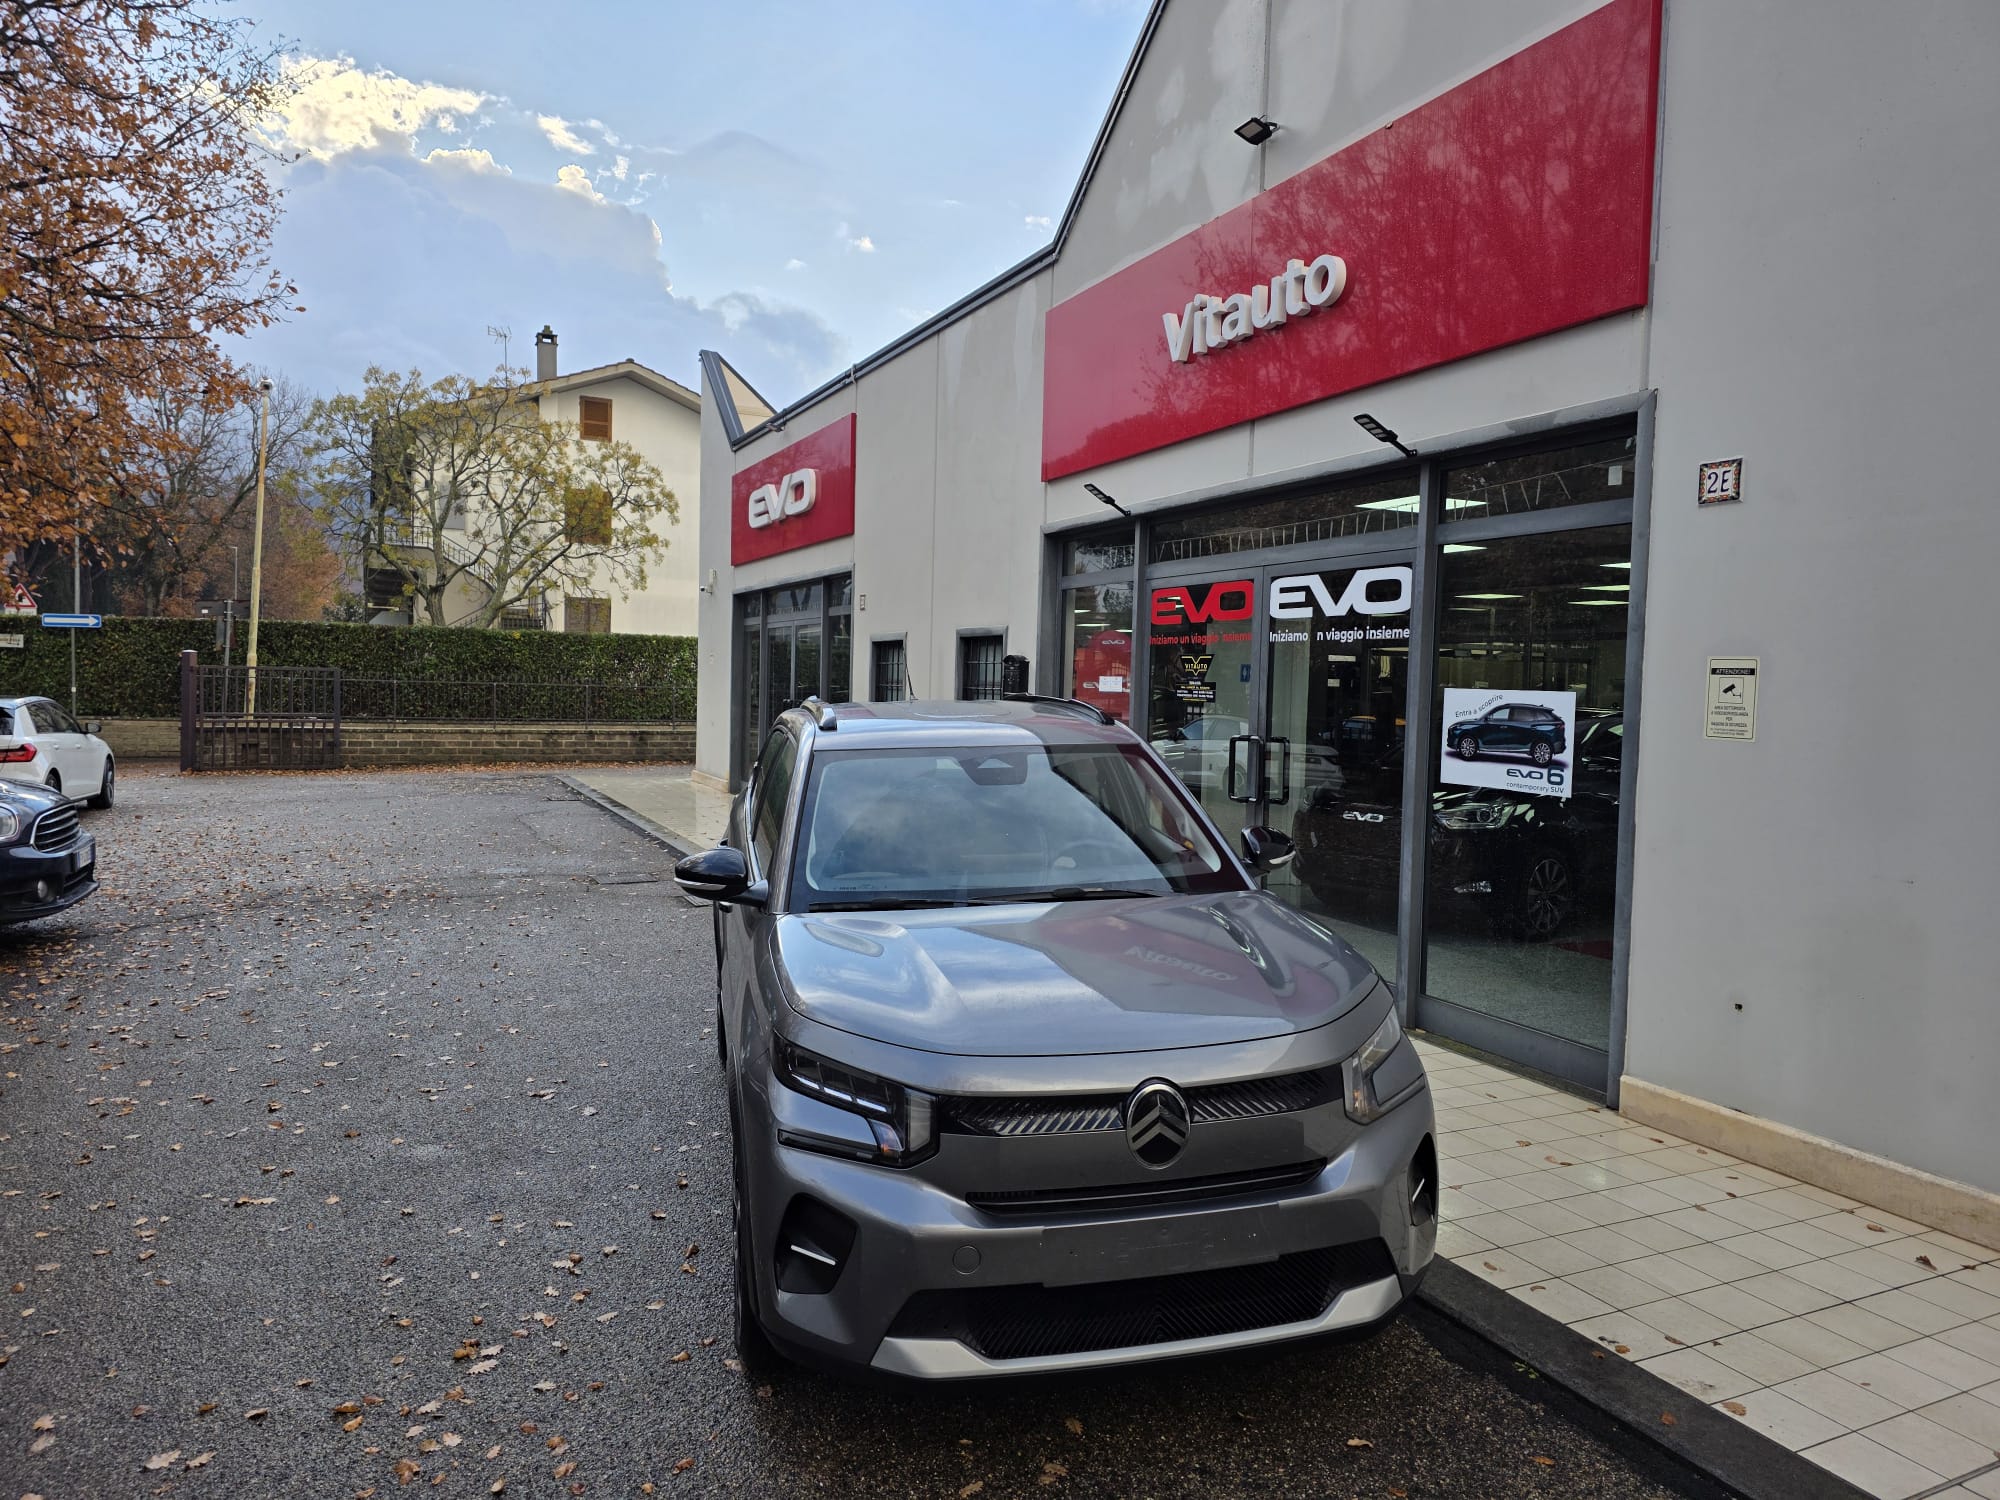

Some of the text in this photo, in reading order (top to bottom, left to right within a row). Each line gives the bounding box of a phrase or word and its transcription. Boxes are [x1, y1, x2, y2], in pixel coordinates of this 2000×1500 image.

[1163, 254, 1346, 363] Vitauto
[1707, 469, 1732, 493] 2E
[749, 468, 816, 528] EVO
[1151, 580, 1254, 625] EVO
[1269, 566, 1412, 619] EVO
[1180, 634, 1190, 645] un
[1269, 629, 1308, 642] Iniziamo
[1326, 627, 1364, 643] viaggio
[1366, 625, 1410, 640] insieme
[1455, 709, 1473, 718] Entra
[1506, 765, 1565, 786] EVO 6
[1506, 781, 1549, 793] contemporary
[1343, 810, 1384, 823] EVO
